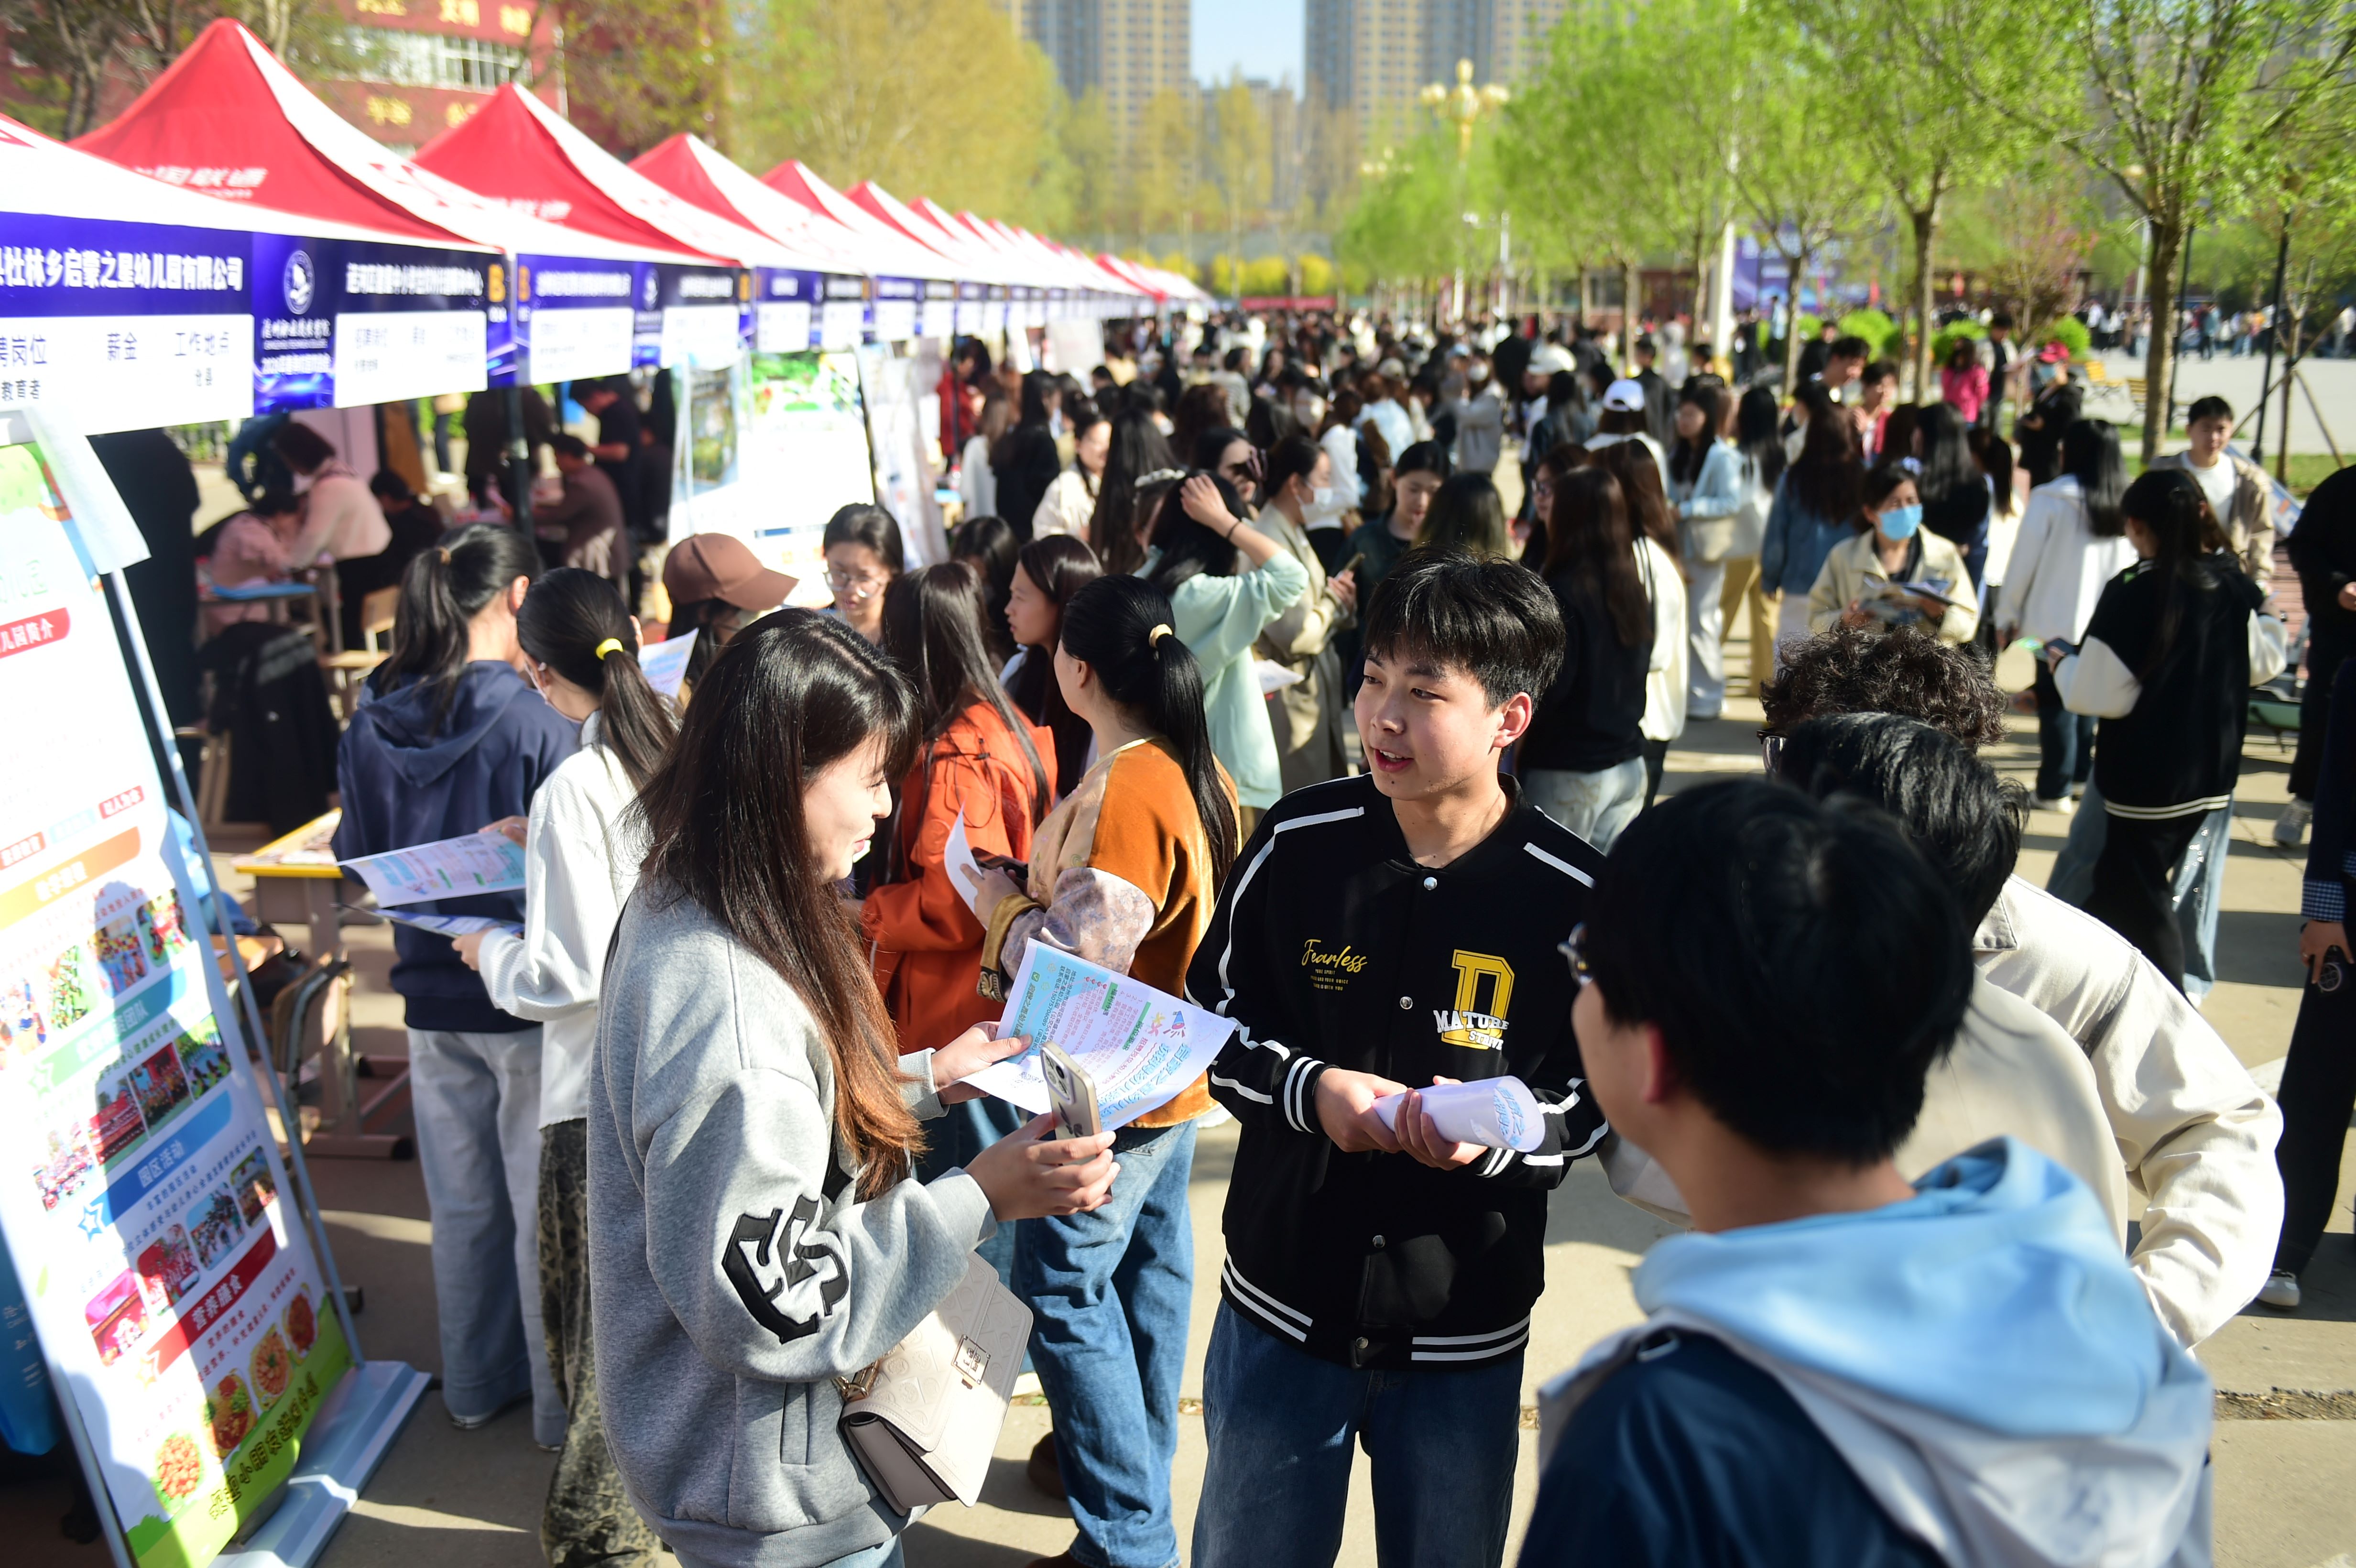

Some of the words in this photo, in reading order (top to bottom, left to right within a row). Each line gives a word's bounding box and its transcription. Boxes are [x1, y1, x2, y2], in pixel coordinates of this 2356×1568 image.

[1301, 939, 1368, 973] Fearless
[1082, 987, 1099, 1021] 工资待遇面议
[1102, 988, 1117, 1016] 福利待遇
[1123, 1021, 1144, 1051] 岗位要求
[1433, 1010, 1509, 1033] MATURE
[1469, 1030, 1504, 1051] STRIVE
[138, 1140, 185, 1188] 园区活动
[192, 1274, 242, 1331] 营养膳食
